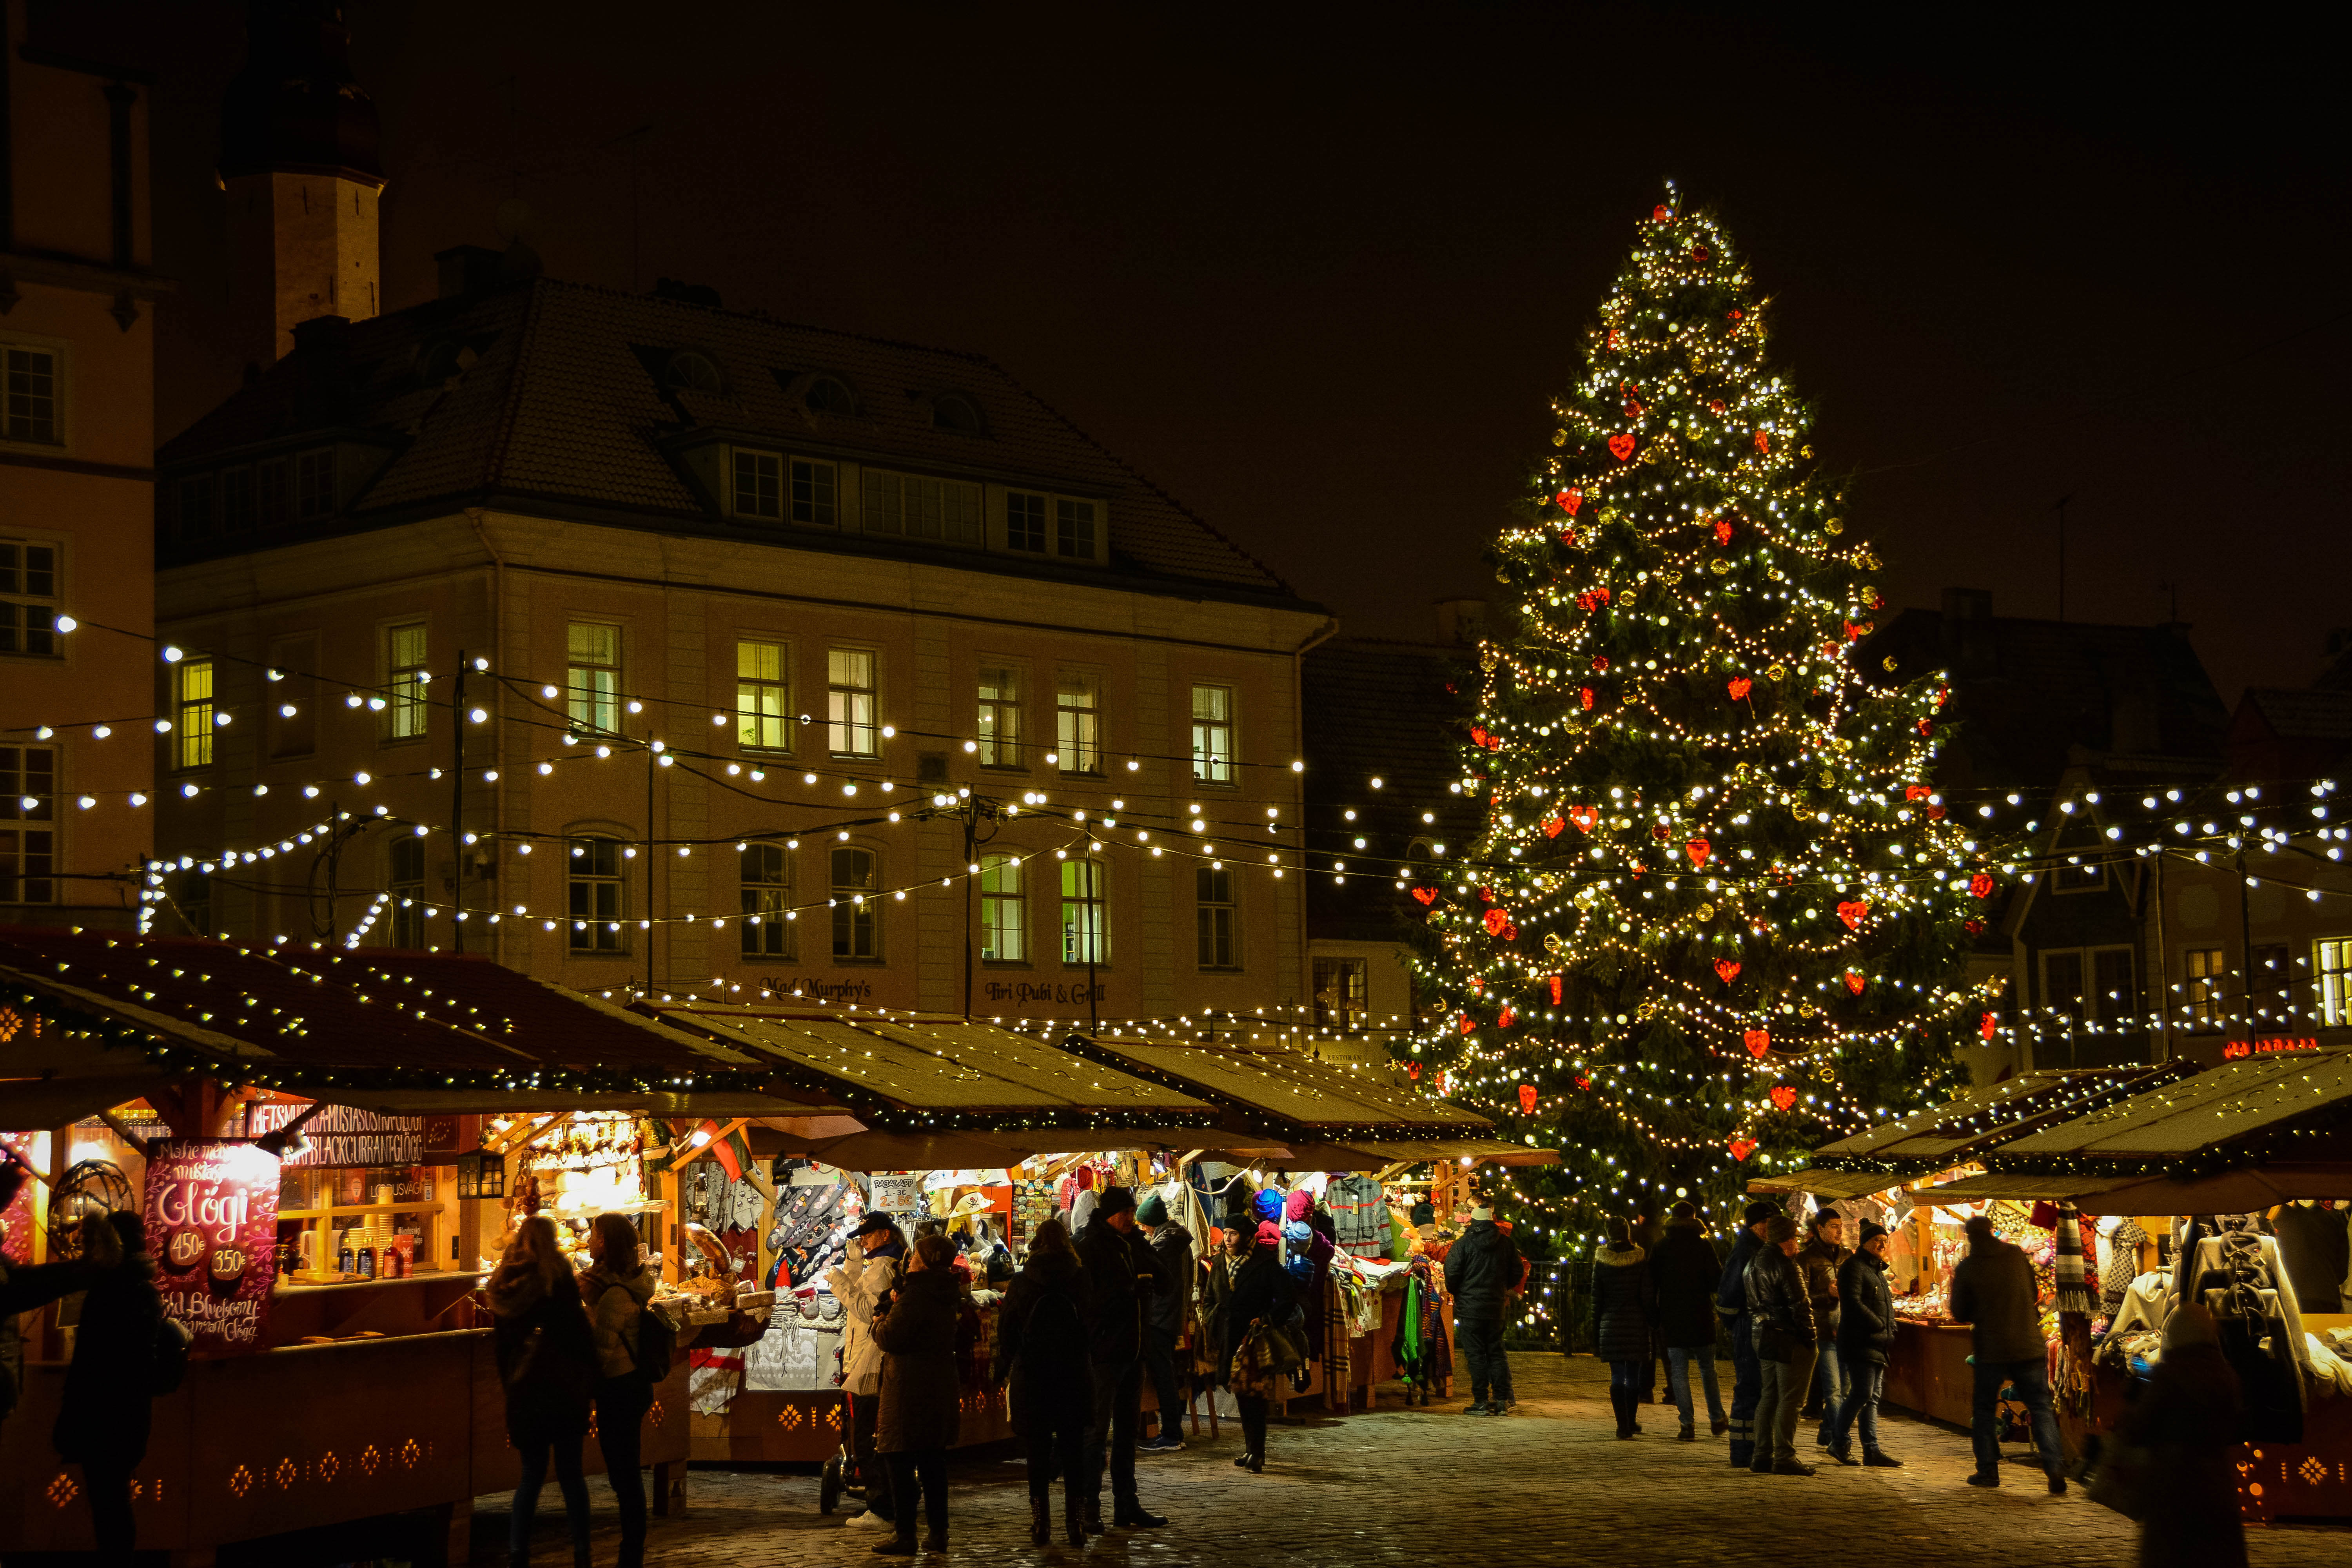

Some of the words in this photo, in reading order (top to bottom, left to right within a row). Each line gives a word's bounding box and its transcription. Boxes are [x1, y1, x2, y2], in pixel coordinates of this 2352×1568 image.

[759, 977, 798, 1001] Mad
[801, 978, 871, 1004] Murphy's
[1016, 983, 1052, 1007] Pubi
[1056, 984, 1068, 1003] &
[1071, 984, 1106, 1005] Grll
[873, 1178, 913, 1189] PAJALAPP
[158, 1181, 248, 1243] Glögi
[897, 1195, 913, 1206] 5€
[214, 1250, 246, 1272] 3.50€
[161, 1292, 185, 1318] ild
